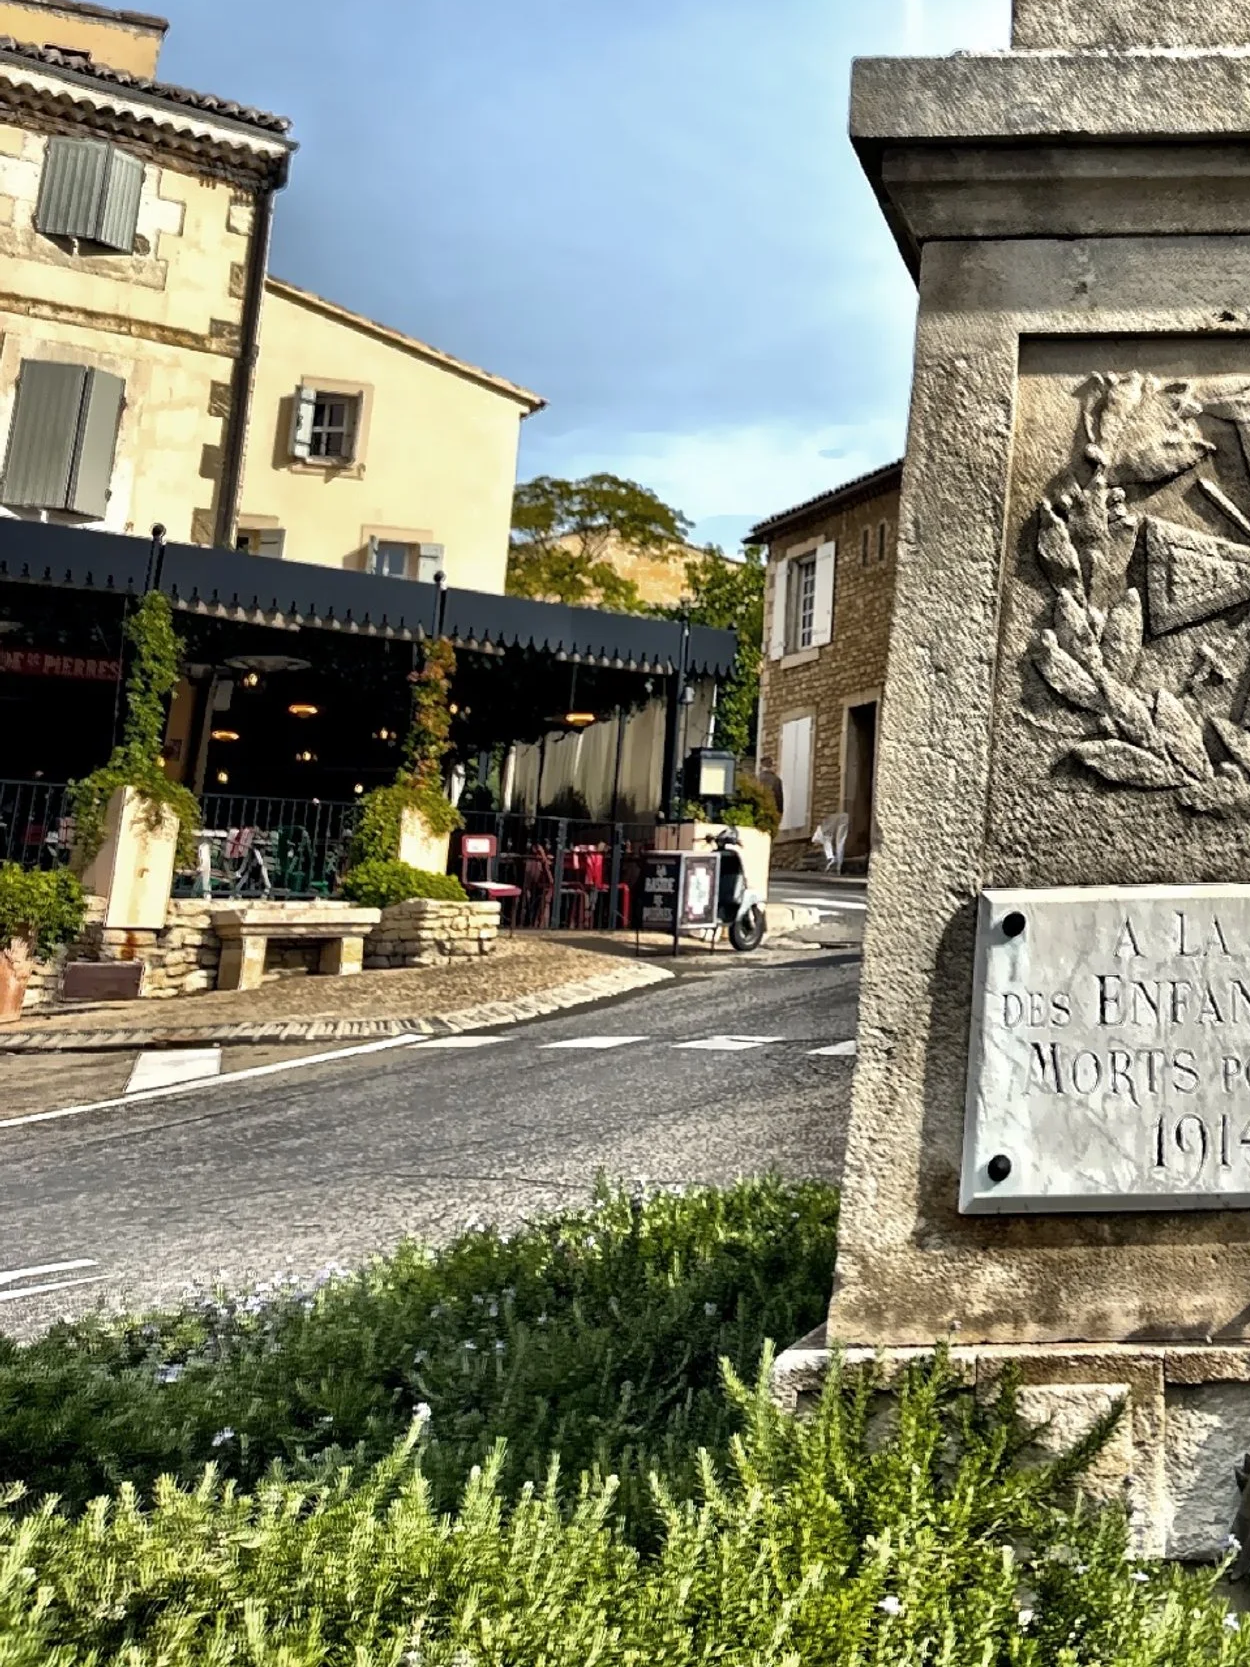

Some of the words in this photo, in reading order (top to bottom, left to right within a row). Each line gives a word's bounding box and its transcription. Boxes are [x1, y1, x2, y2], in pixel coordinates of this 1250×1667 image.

[42, 654, 121, 681] PIERRES
[1113, 915, 1146, 958] A
[1175, 908, 1232, 960] LA
[1001, 990, 1073, 1029] DES
[1022, 1041, 1202, 1109] MORTS
